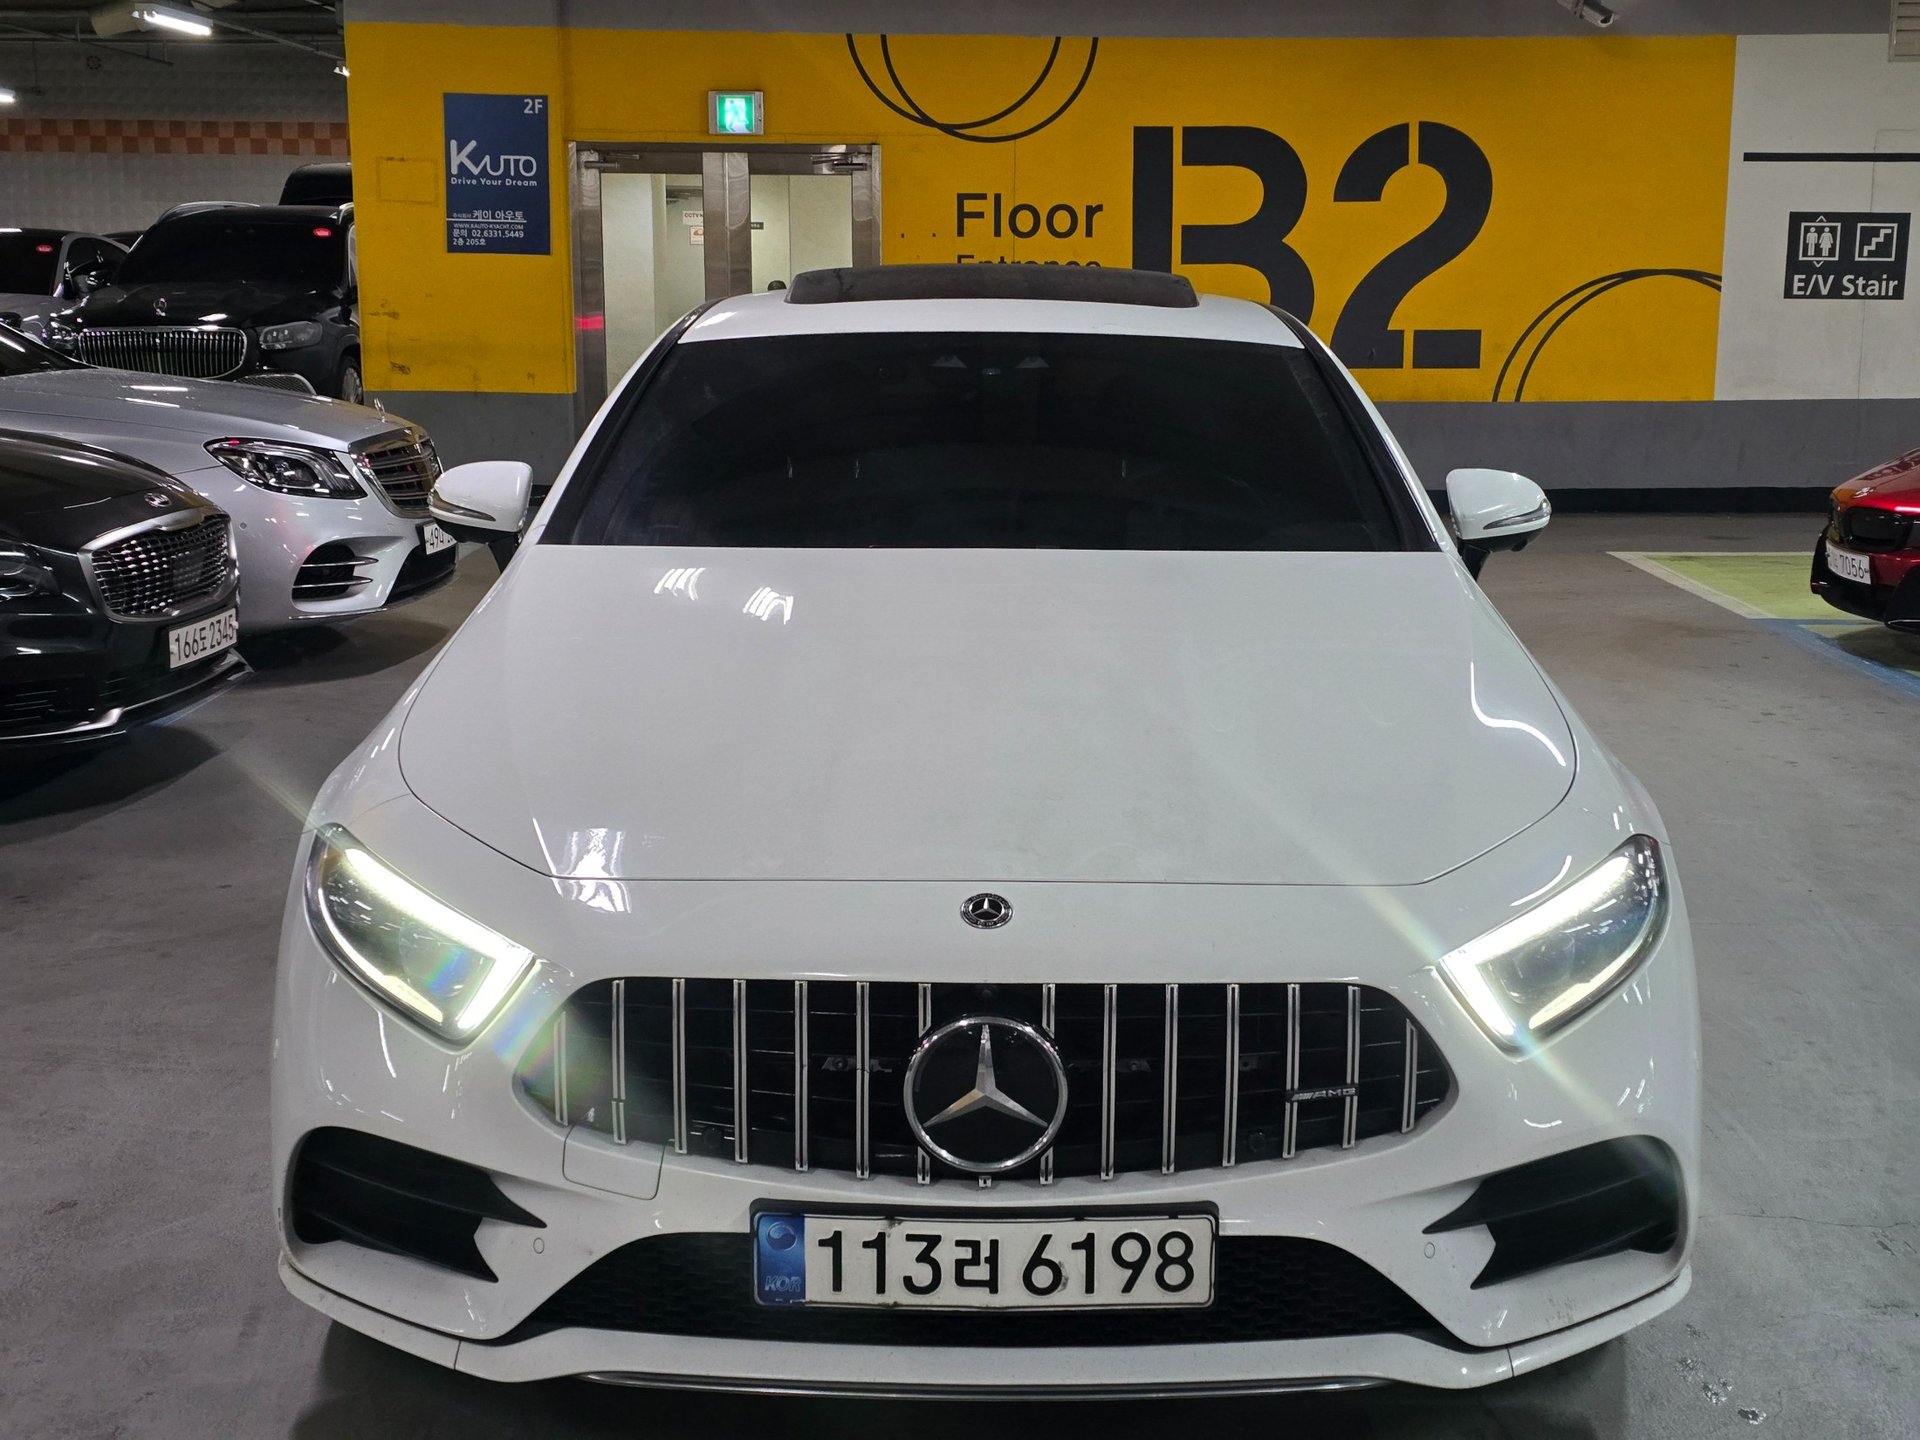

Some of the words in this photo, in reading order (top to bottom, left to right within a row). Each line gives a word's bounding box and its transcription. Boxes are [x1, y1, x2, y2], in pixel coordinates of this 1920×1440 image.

[523, 98, 543, 114] 2F
[450, 176, 477, 186] Drive
[480, 178, 502, 186] Your
[505, 178, 538, 187] Dream
[472, 209, 492, 220] 케이
[495, 209, 525, 221] 아우토
[956, 192, 1104, 239] Floor
[453, 228, 468, 238] 문의
[1132, 120, 1493, 369] B2
[1792, 274, 1835, 296] E/V
[1841, 273, 1899, 297] Stair
[1839, 553, 1865, 579] 7056
[1021, 1230, 1196, 1296] 6198
[764, 1275, 802, 1293] KOR
